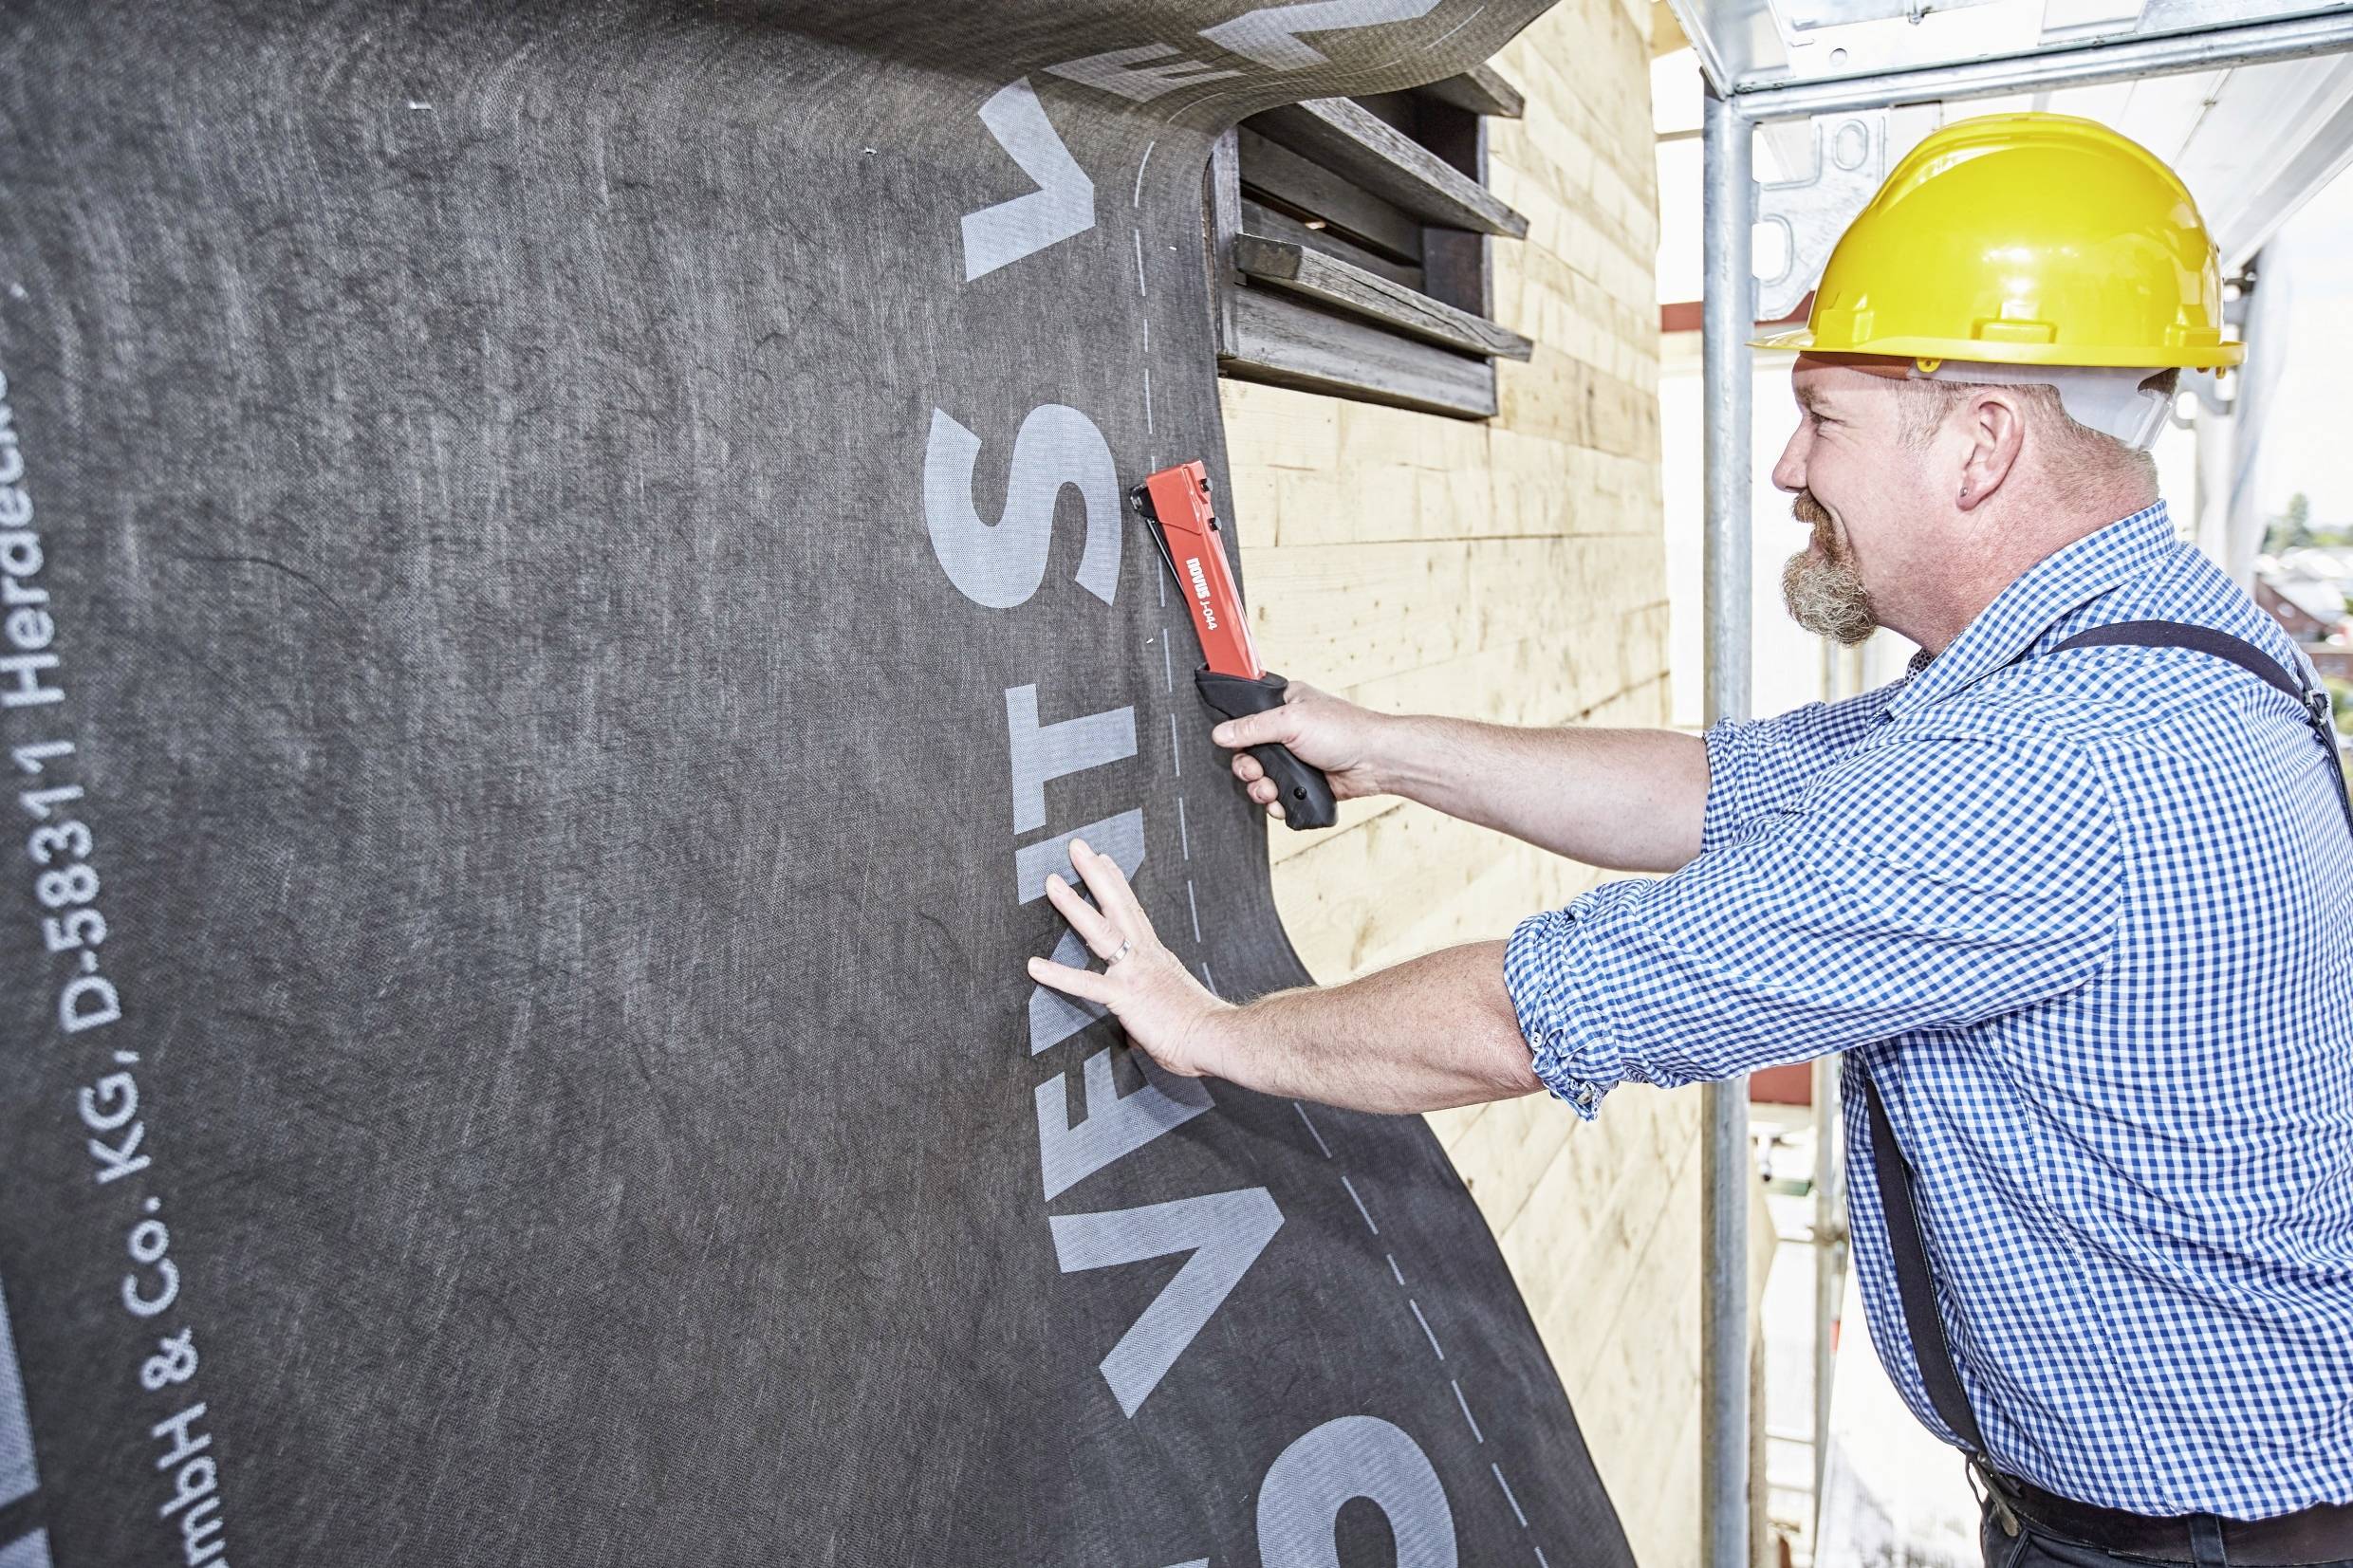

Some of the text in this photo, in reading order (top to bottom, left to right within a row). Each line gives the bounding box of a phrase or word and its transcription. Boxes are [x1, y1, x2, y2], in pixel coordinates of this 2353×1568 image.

[923, 404, 1122, 609] S
[11, 741, 121, 1033] D-58311
[79, 1050, 152, 1184] KG,
[121, 1195, 180, 1317] Co.
[140, 1328, 199, 1391] &
[152, 1402, 230, 1568] mbH
